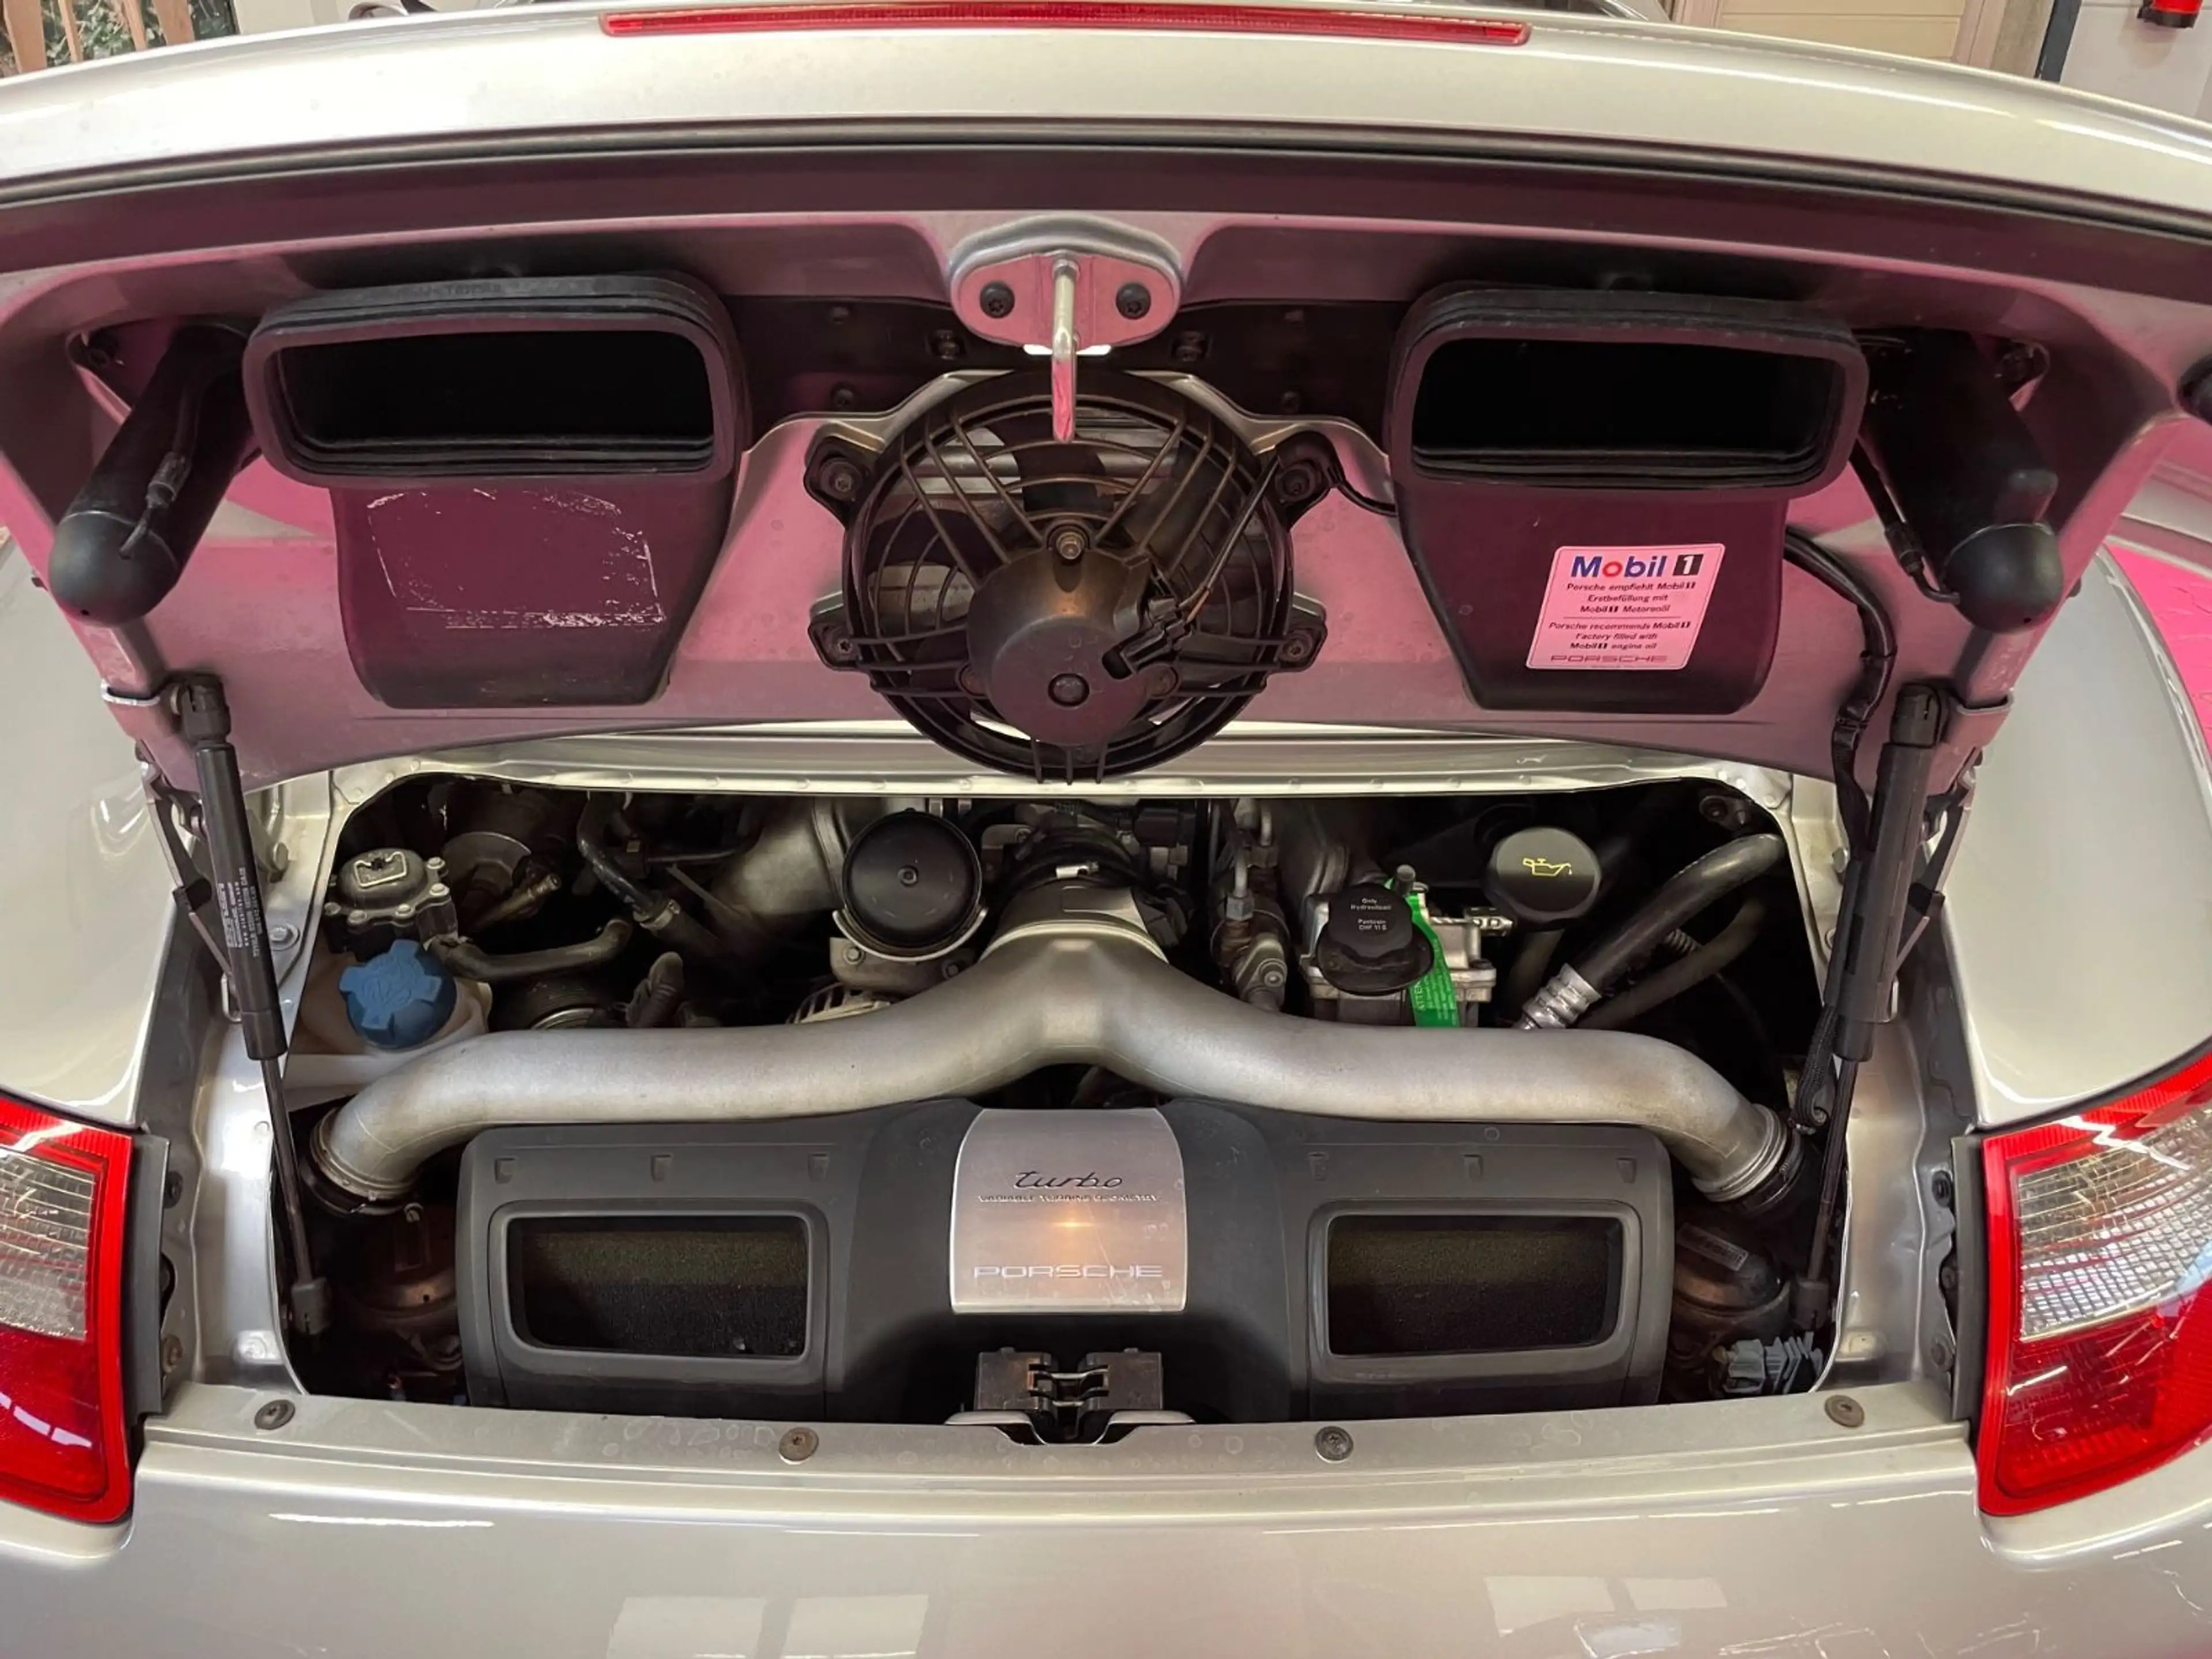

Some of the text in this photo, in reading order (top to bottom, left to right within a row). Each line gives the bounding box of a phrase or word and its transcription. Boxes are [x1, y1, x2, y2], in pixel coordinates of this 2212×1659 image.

[1570, 555, 1668, 578] Mobil
[1566, 583, 1606, 591] Porsche
[1609, 582, 1654, 592] empfiehlt
[1657, 581, 1684, 590] Mobil
[1587, 594, 1650, 603] Erstbefüllung
[1580, 605, 1608, 613] Mobil
[1622, 604, 1671, 612] Motorenöl
[1548, 622, 1589, 630] Porsche
[1589, 622, 1651, 630] recommends
[1014, 1171, 1123, 1190] turbo
[975, 1264, 1162, 1279] PORSCHE
